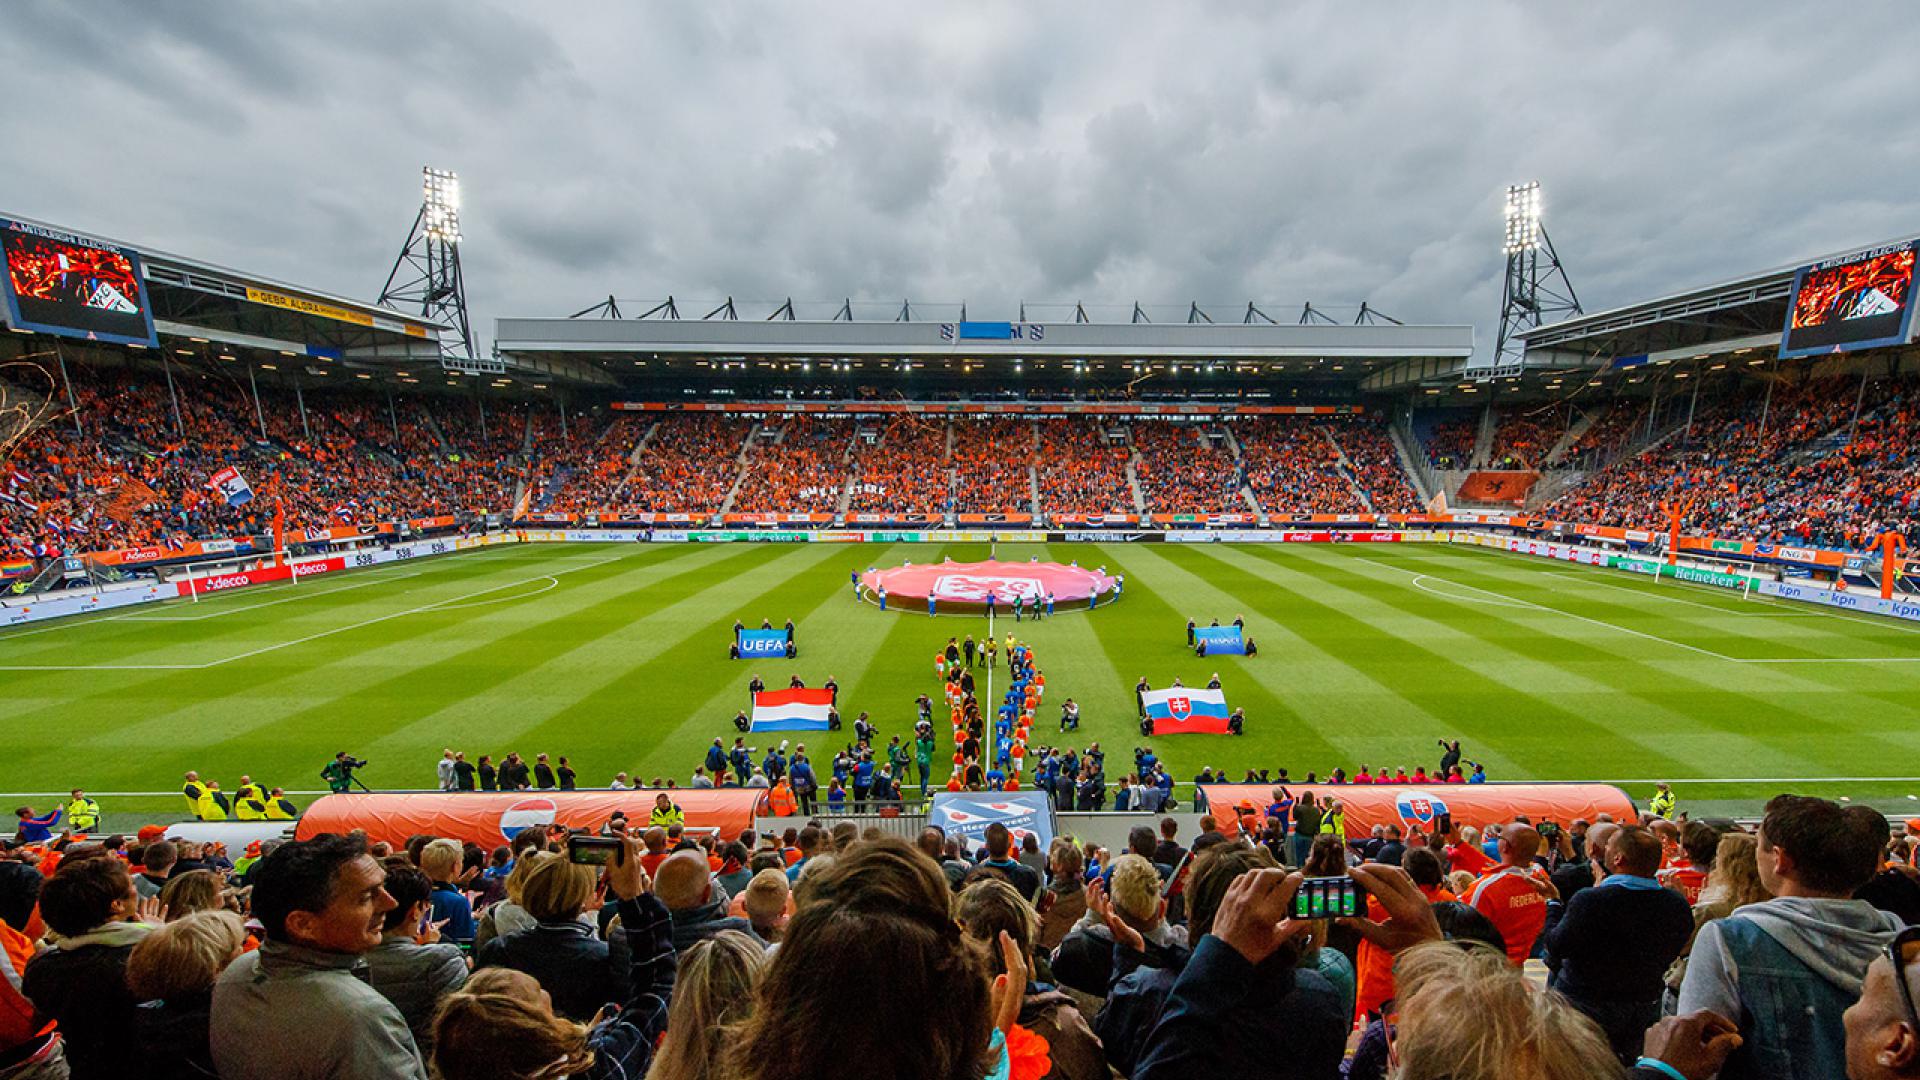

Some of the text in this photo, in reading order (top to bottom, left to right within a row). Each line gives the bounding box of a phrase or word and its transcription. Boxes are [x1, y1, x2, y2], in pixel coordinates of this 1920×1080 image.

[356, 554, 373, 565] 538
[1674, 567, 1734, 587] Heineken
[1778, 584, 1801, 597] kpn
[1831, 592, 1857, 606] kpn
[1892, 602, 1920, 618] kpn
[743, 639, 784, 651] UEFA
